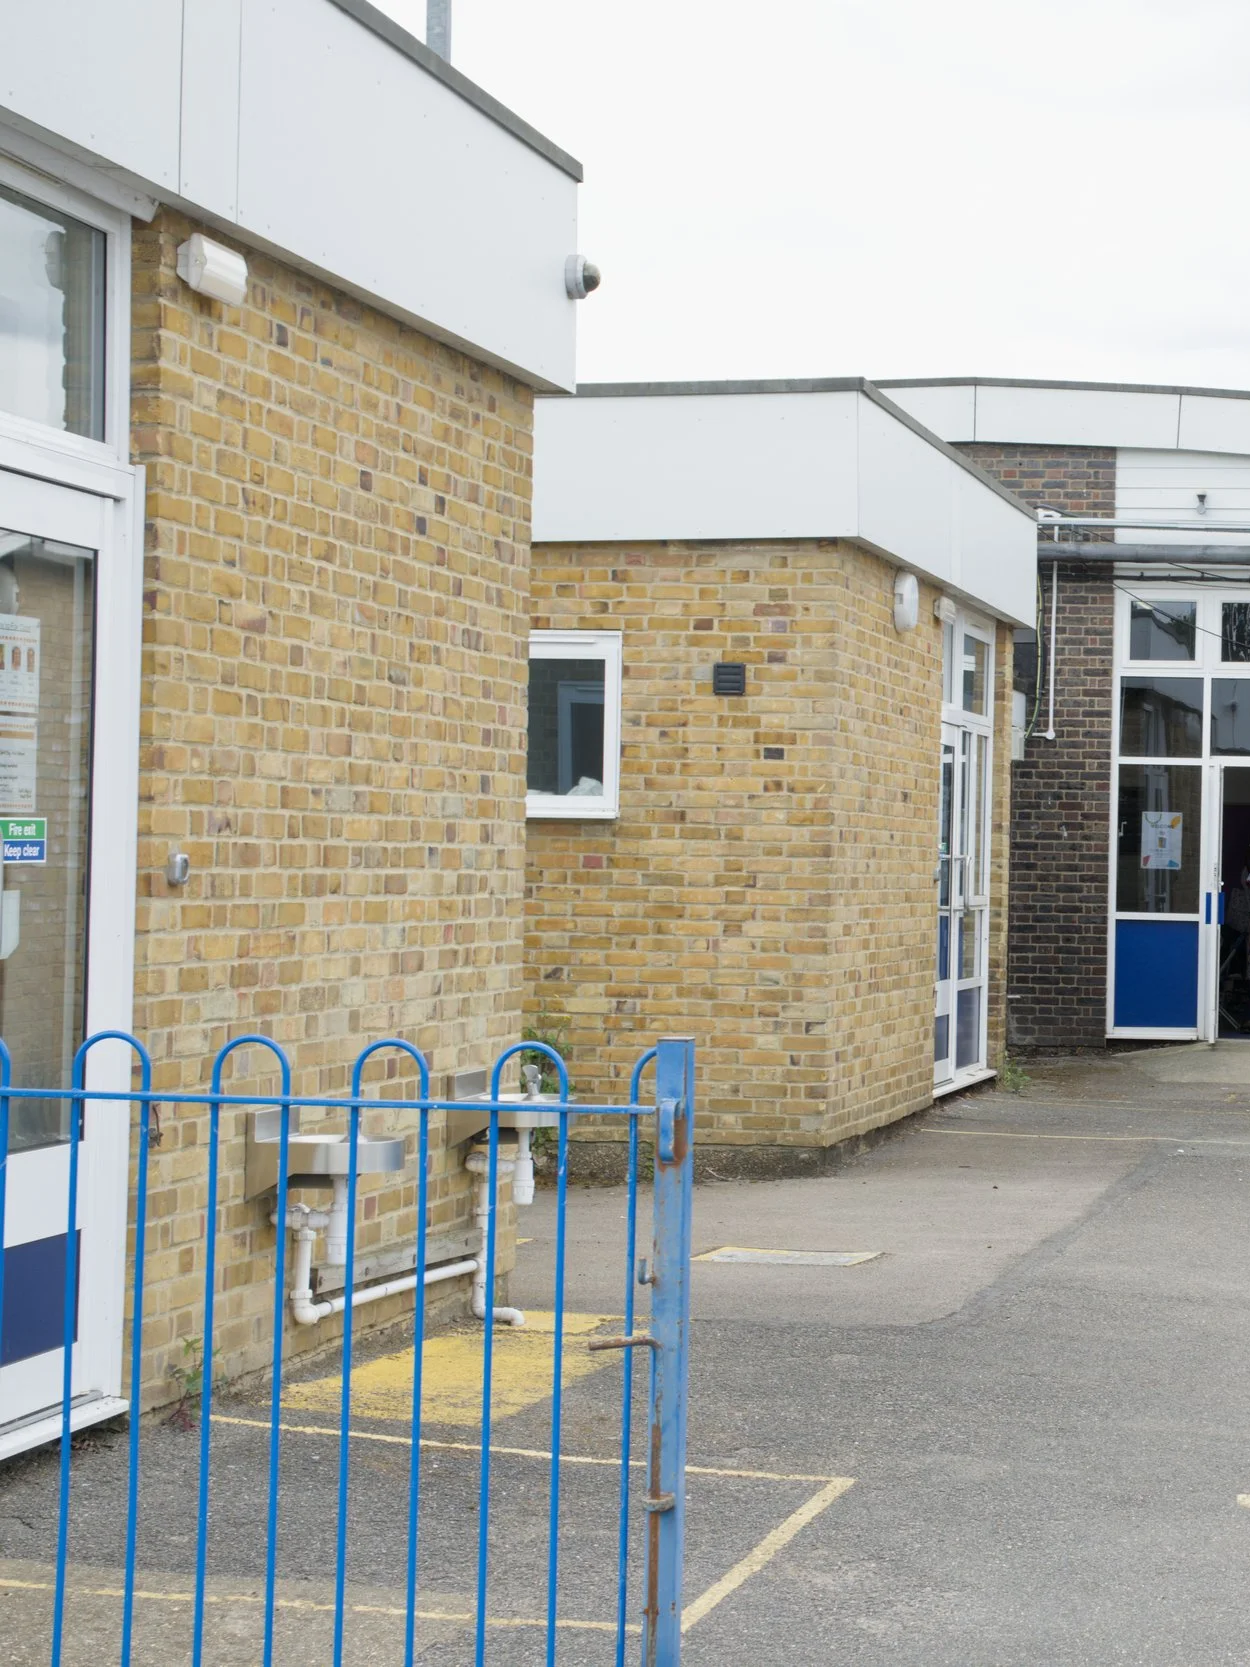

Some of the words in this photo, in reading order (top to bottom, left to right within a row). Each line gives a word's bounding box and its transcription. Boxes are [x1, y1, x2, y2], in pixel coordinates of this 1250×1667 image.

[8, 822, 23, 836] Fire
[23, 823, 36, 836] exit
[4, 843, 22, 859] Keep
[22, 844, 40, 857] clear
